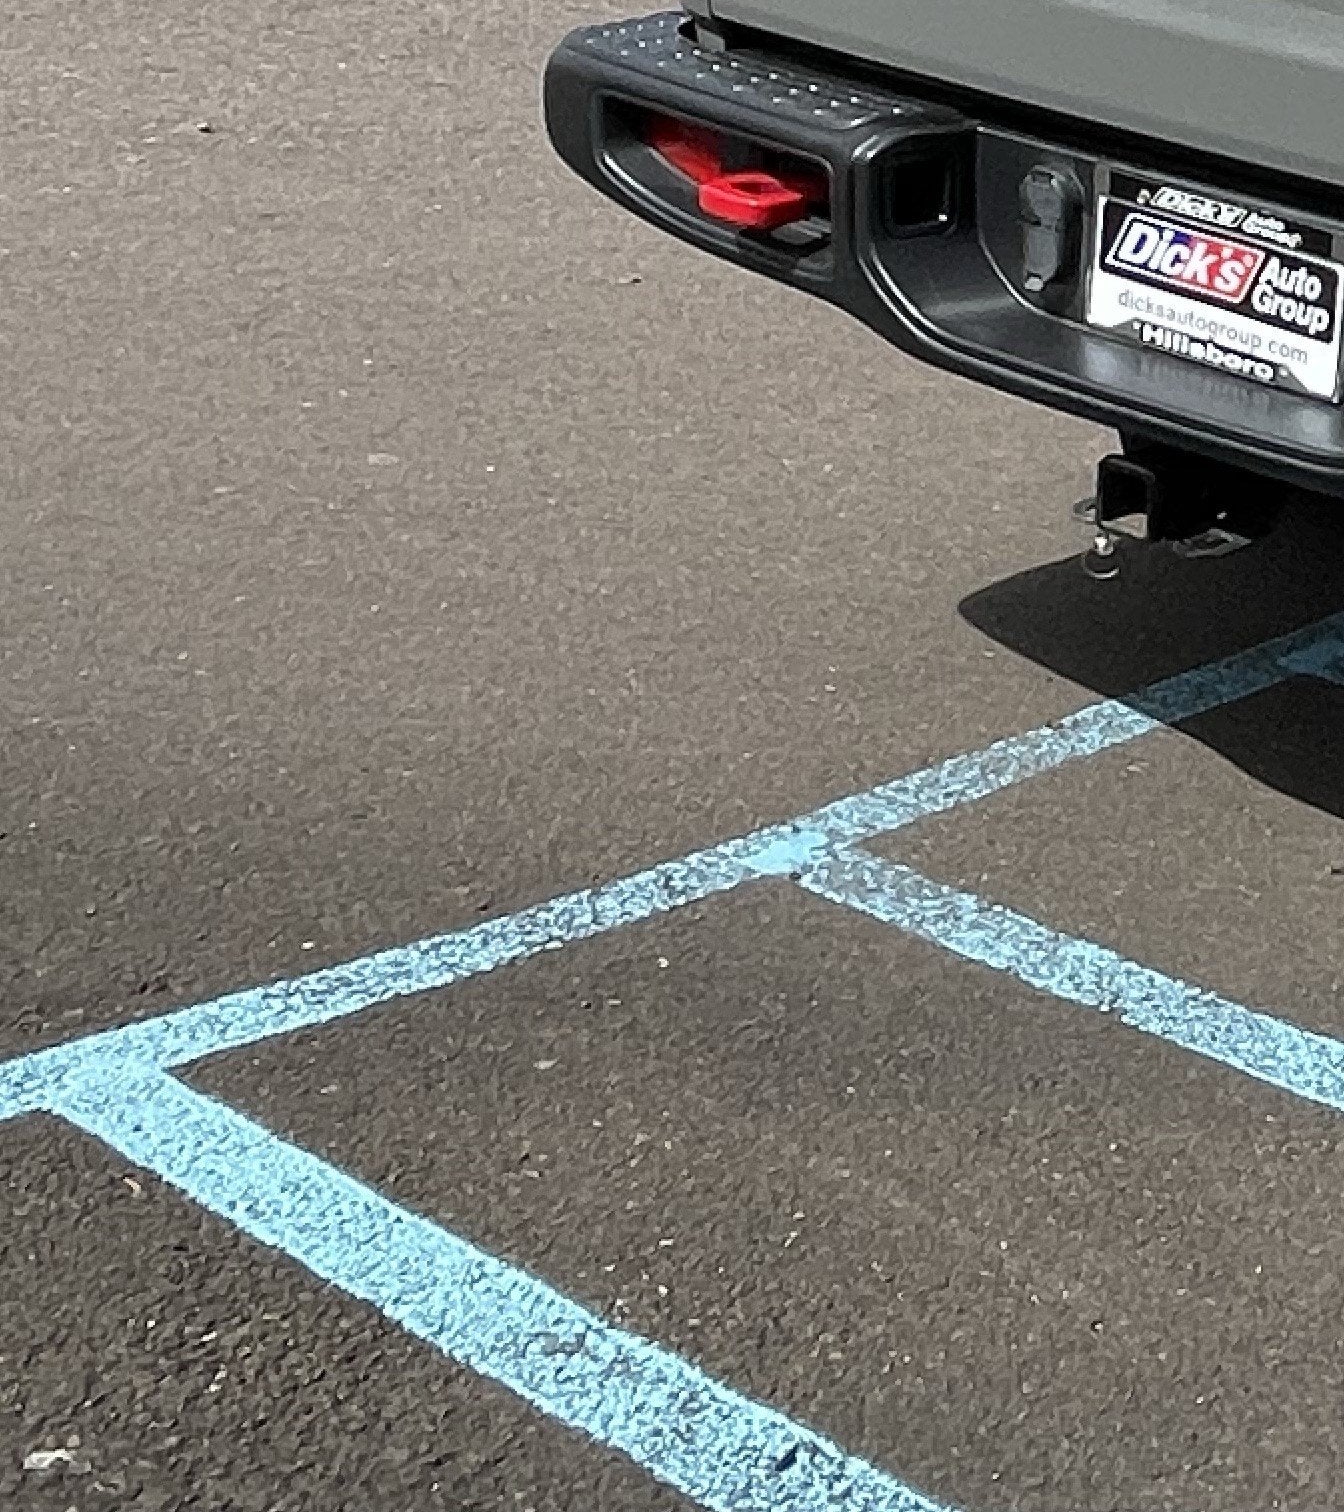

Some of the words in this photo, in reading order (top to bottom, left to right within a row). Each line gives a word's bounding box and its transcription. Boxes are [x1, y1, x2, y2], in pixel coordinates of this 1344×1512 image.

[1261, 256, 1323, 301] Auto
[1252, 284, 1330, 336] Group
[1141, 322, 1275, 381] Hillsboro
